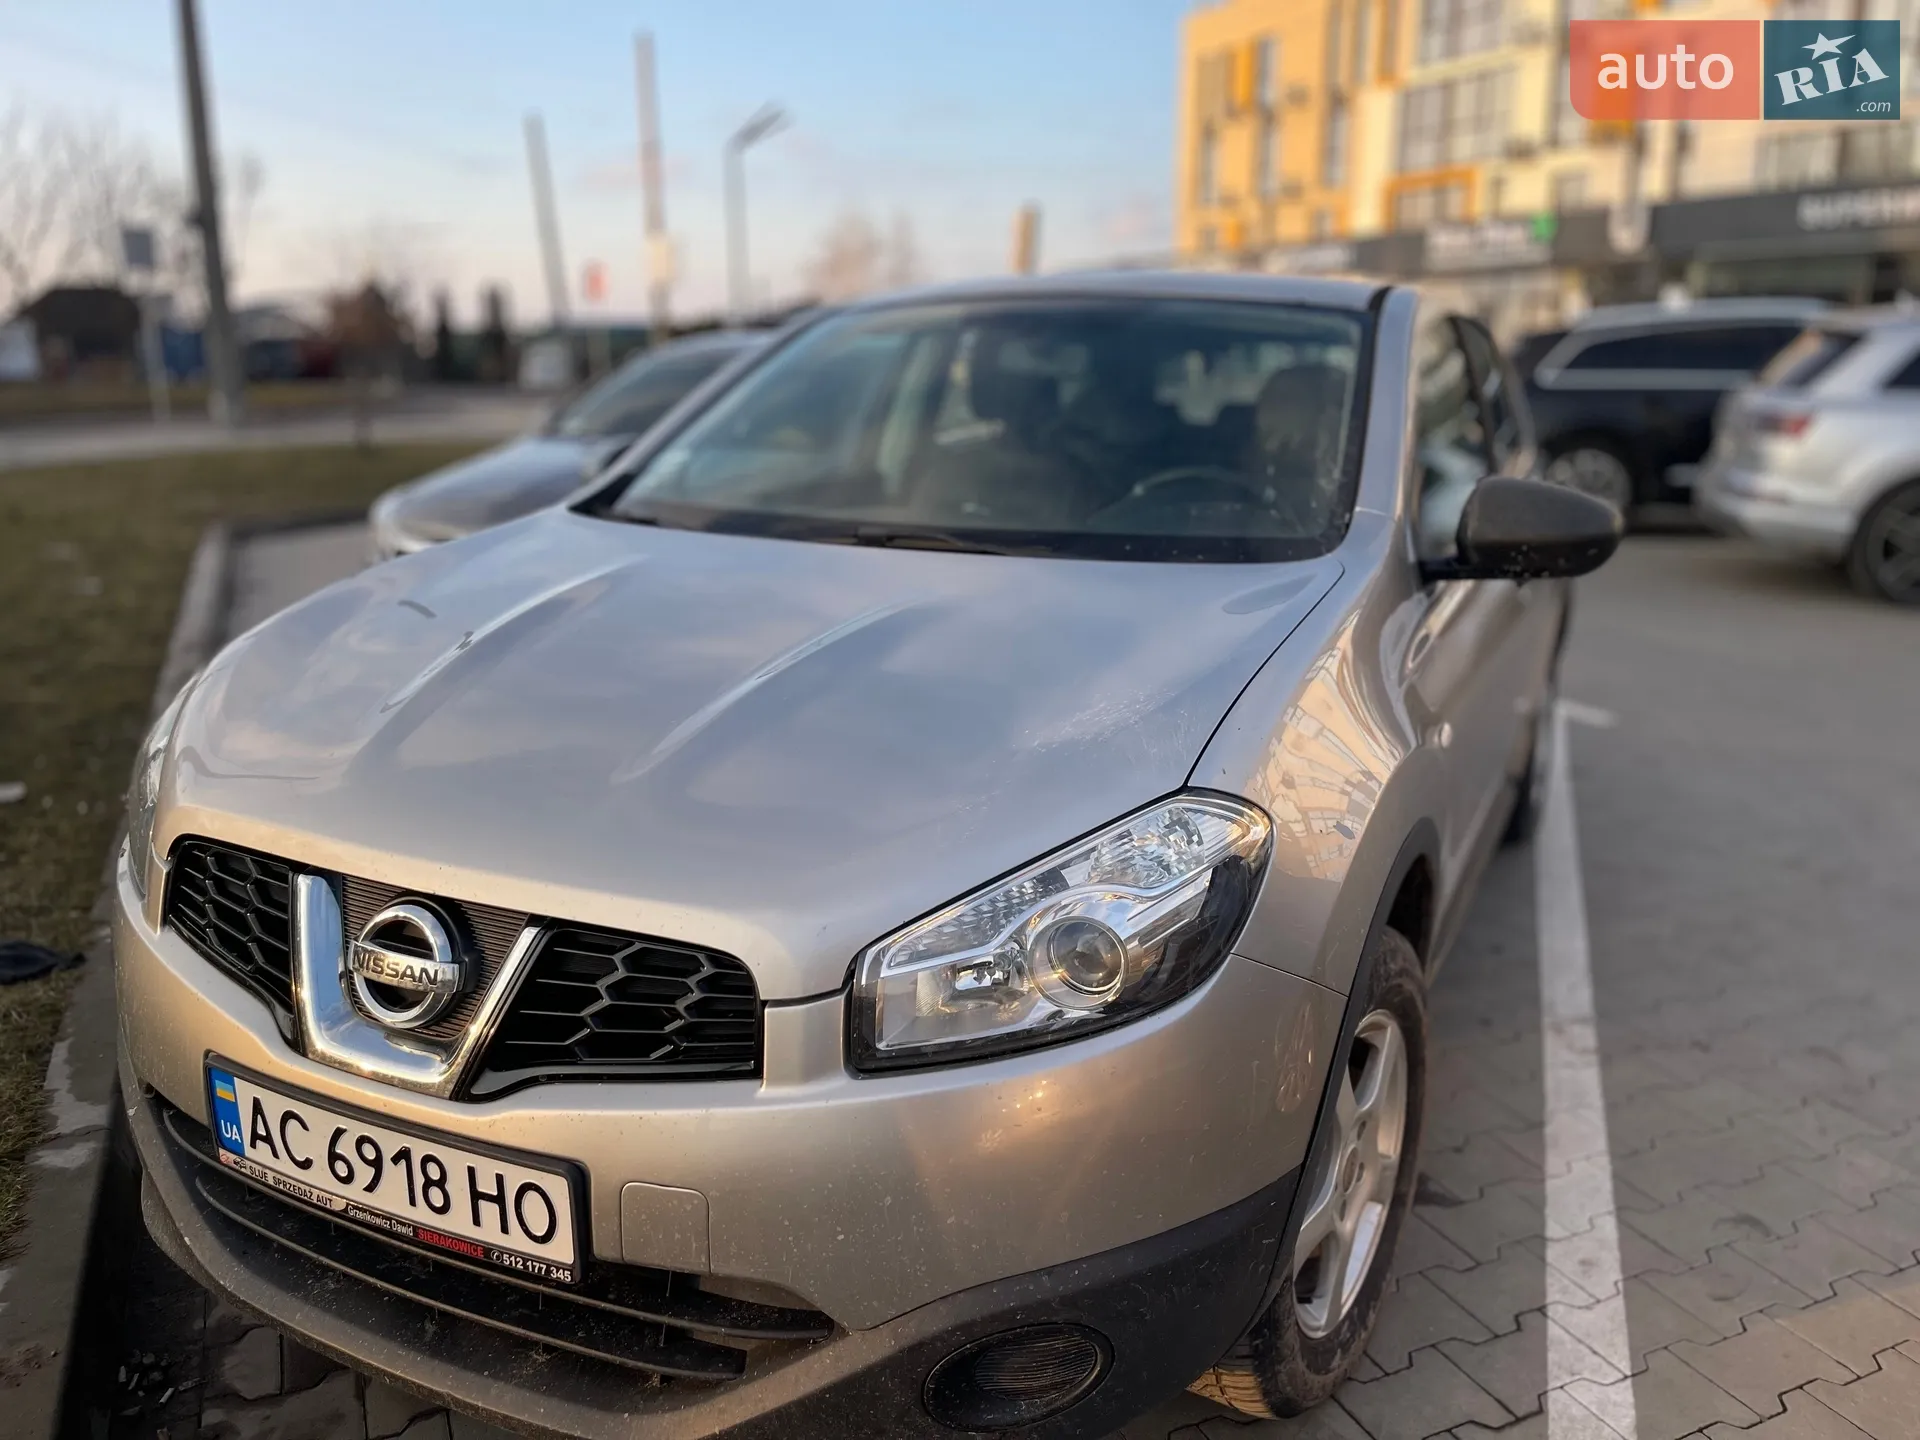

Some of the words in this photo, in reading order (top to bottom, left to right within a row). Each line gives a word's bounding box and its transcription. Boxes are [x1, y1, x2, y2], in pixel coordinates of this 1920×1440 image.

[351, 946, 439, 987] NISSAN
[221, 1120, 241, 1143] UA
[249, 1096, 314, 1170] AC
[327, 1125, 452, 1215] 6918
[467, 1164, 557, 1244] HO
[272, 1176, 314, 1201] SPRZEDAŻ
[315, 1194, 333, 1208] AUT
[347, 1205, 391, 1229] Grzenkowicz
[391, 1220, 414, 1236] Dawid
[417, 1228, 485, 1258] SIERAKOWICE
[503, 1253, 524, 1270] 512
[526, 1260, 547, 1275] 177
[550, 1266, 572, 1282] 345
